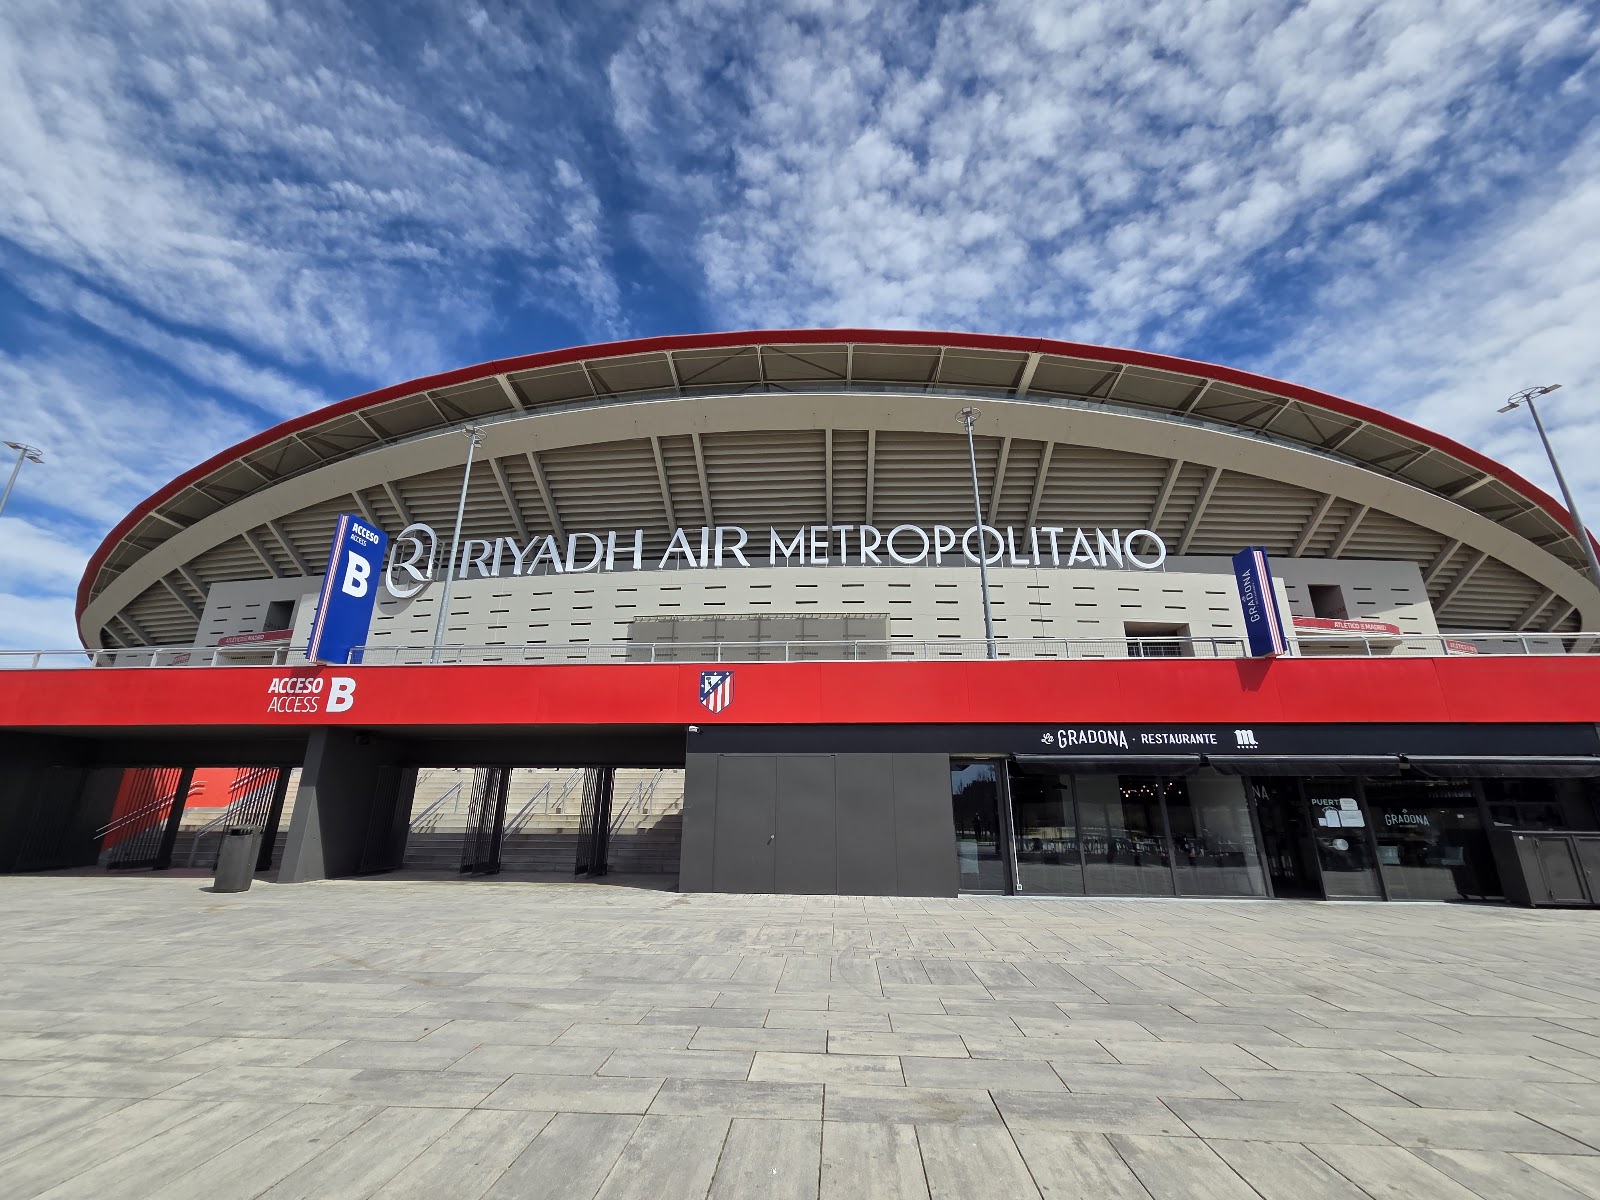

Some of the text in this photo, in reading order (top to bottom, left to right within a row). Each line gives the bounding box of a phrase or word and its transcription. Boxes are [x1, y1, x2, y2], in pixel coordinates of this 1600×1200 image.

[350, 533, 367, 547] ACCESS
[352, 522, 380, 545] ACCESO
[458, 523, 1167, 579] RIYADH AIR METROPOLITANO
[341, 550, 371, 598] B
[1241, 568, 1260, 623] GRADONA
[267, 676, 357, 713] ACCESO B
[267, 696, 319, 713] ACCESS
[1040, 732, 1055, 745] La
[1057, 729, 1129, 750] GRADONA
[1140, 733, 1218, 745] RESTAURANTE
[1311, 798, 1342, 806] PUERT
[1384, 813, 1431, 828] GRADONA
